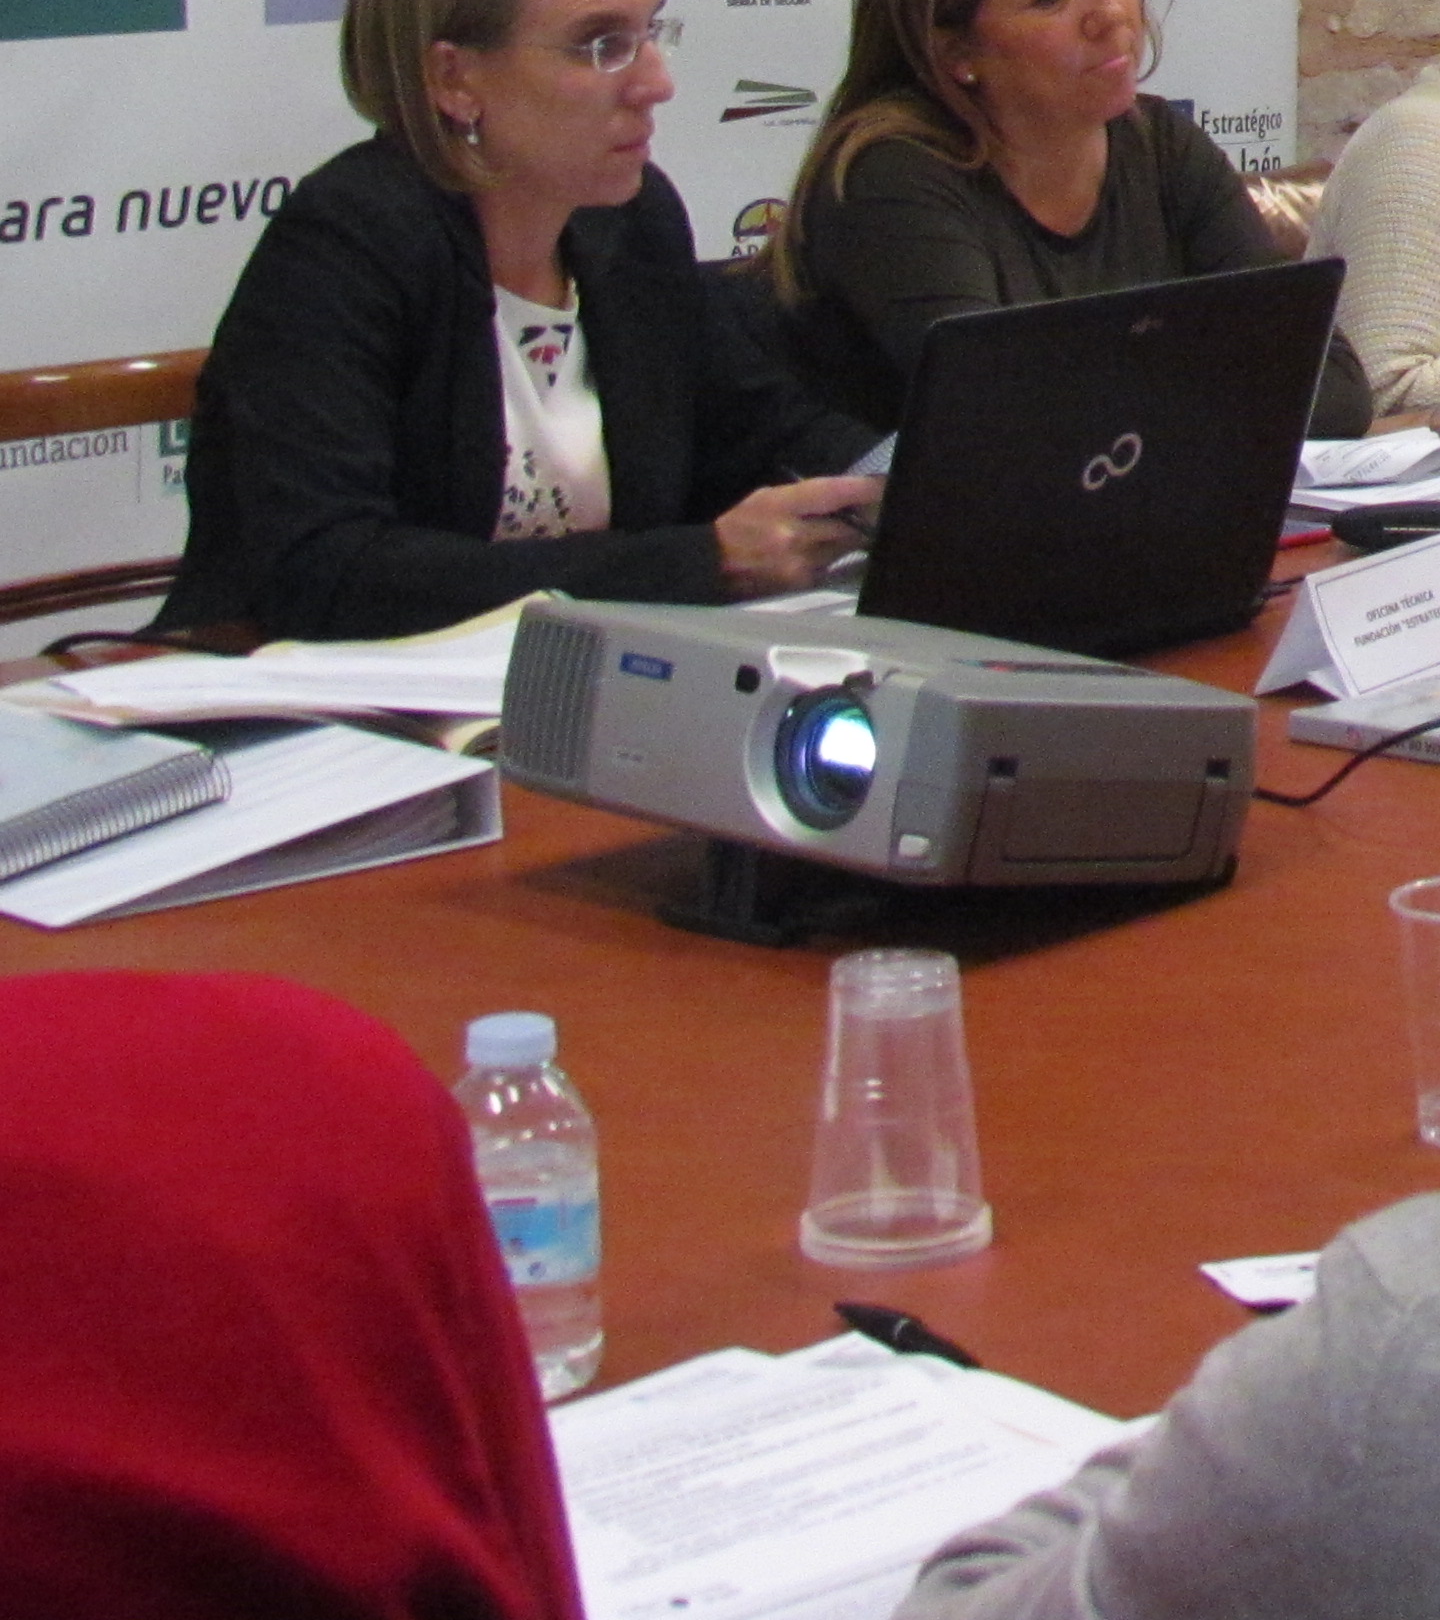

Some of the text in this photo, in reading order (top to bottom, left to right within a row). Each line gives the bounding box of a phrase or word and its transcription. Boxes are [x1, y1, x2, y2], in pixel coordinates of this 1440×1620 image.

[1201, 106, 1283, 139] Estratégico
[1366, 589, 1435, 623] OFICINA TÉCNICA
[1354, 621, 1403, 647] FUNDACIÓN
